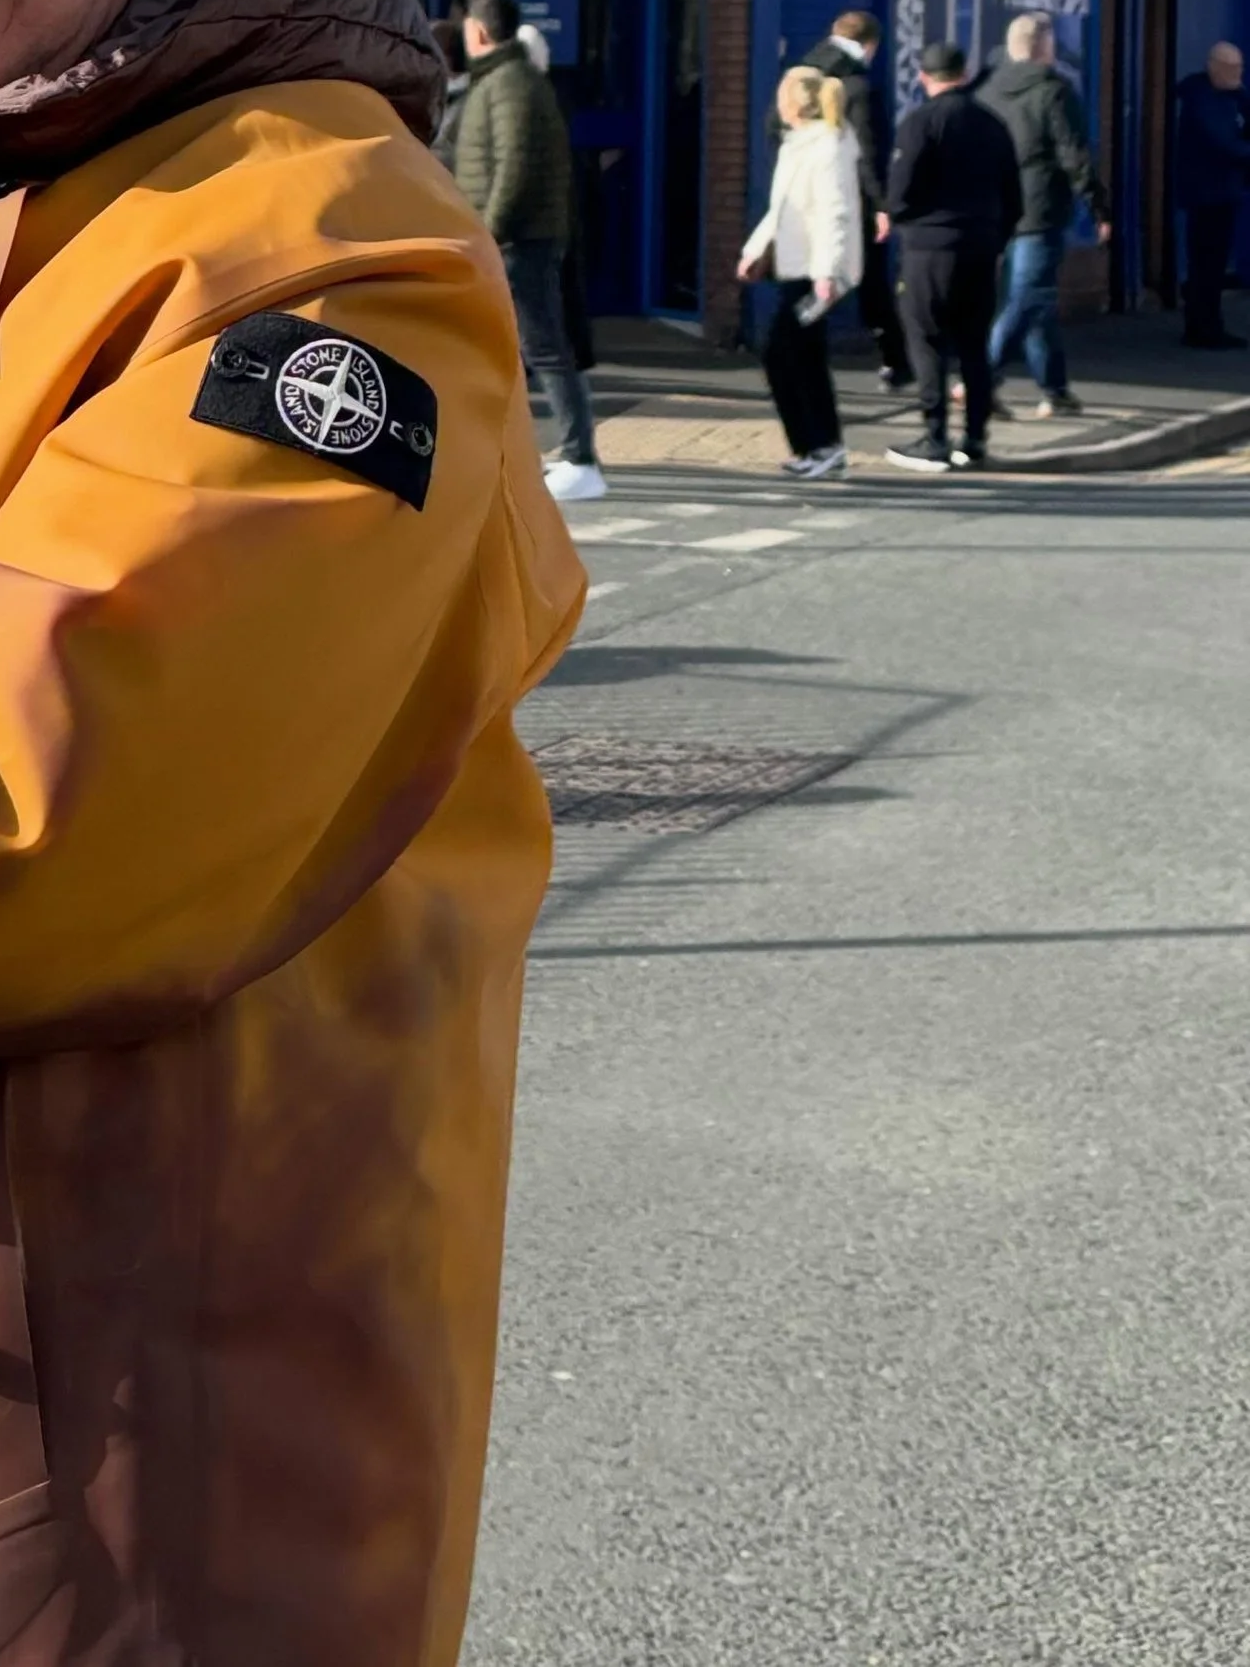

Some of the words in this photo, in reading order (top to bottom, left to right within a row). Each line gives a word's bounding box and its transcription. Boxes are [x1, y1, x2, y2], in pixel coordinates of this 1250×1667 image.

[291, 347, 341, 378] STONE
[351, 356, 380, 410] ISLAND
[284, 386, 320, 436] ISLAND
[330, 416, 374, 445] STONE
